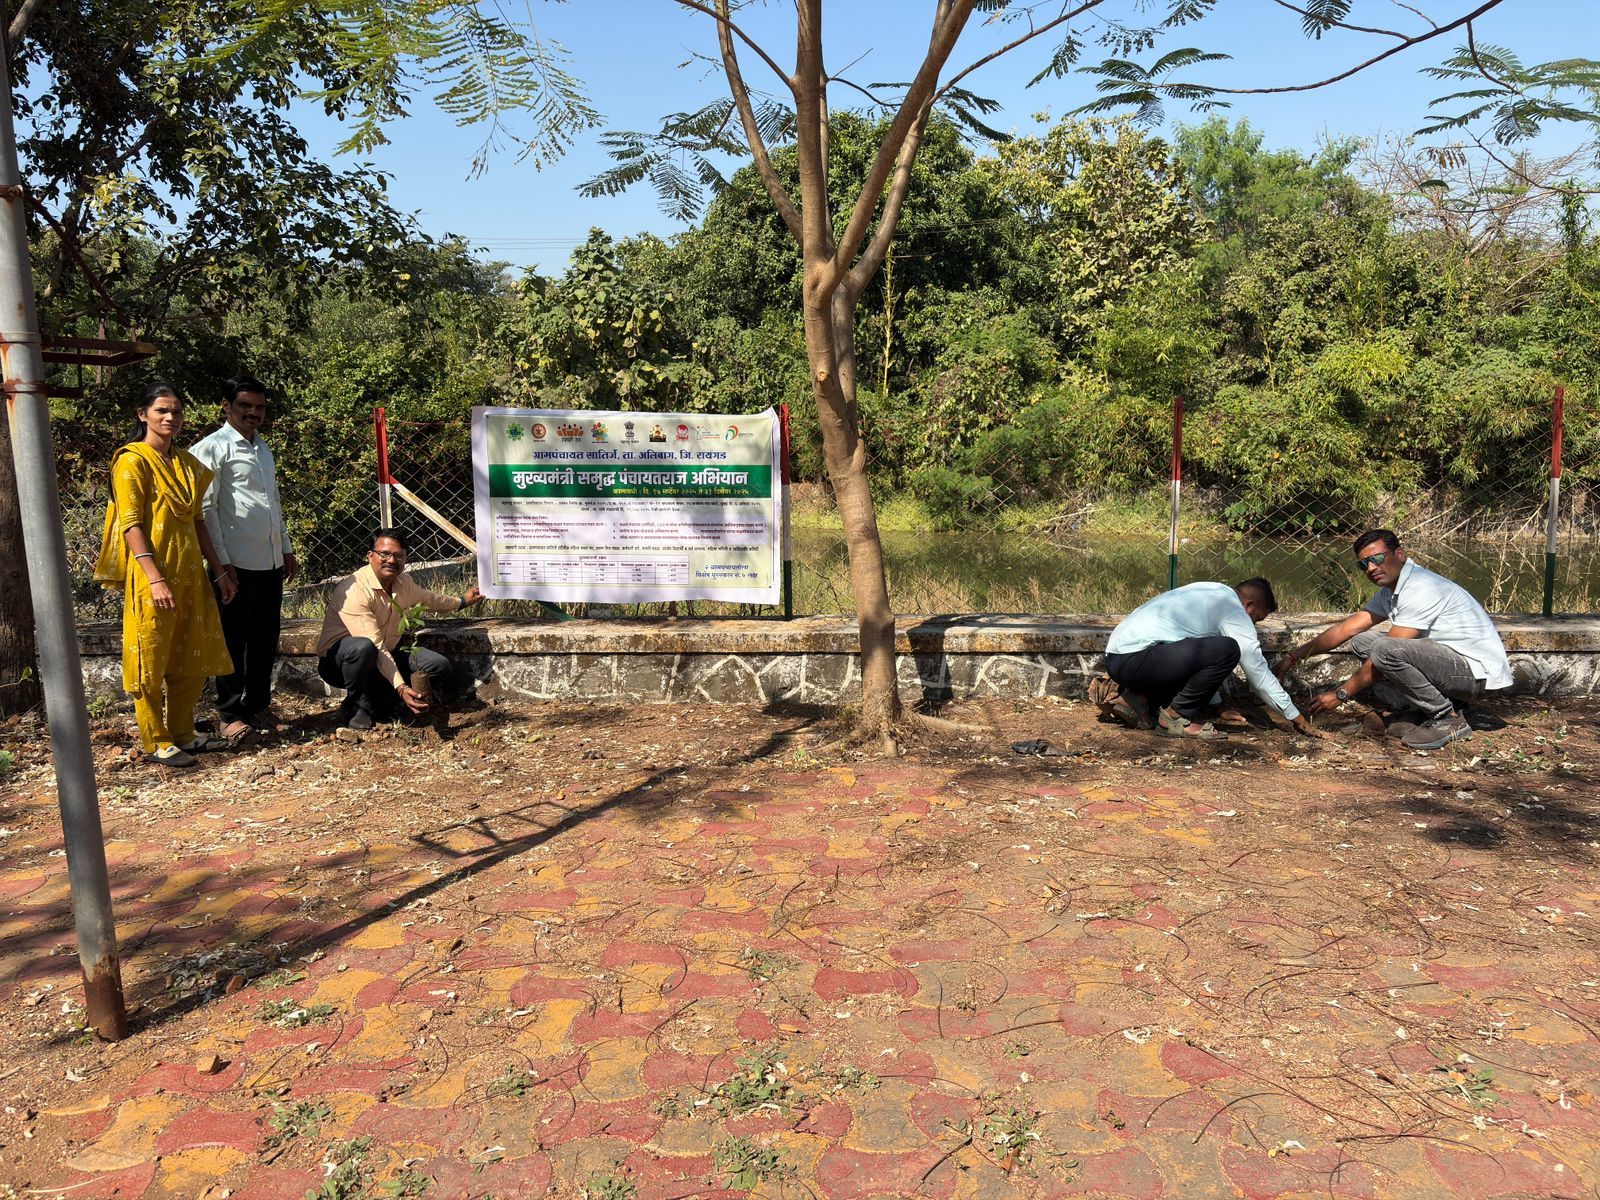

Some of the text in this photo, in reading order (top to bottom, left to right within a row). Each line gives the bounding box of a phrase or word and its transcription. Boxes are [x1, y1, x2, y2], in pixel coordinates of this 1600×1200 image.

[532, 449, 728, 460] ग्रामपंचायत सातिर्जे, ता. अलिबाग, जि. रायगड
[512, 467, 749, 490] मुख्यमंत्री समृद्ध पंचायतराज अभियान
